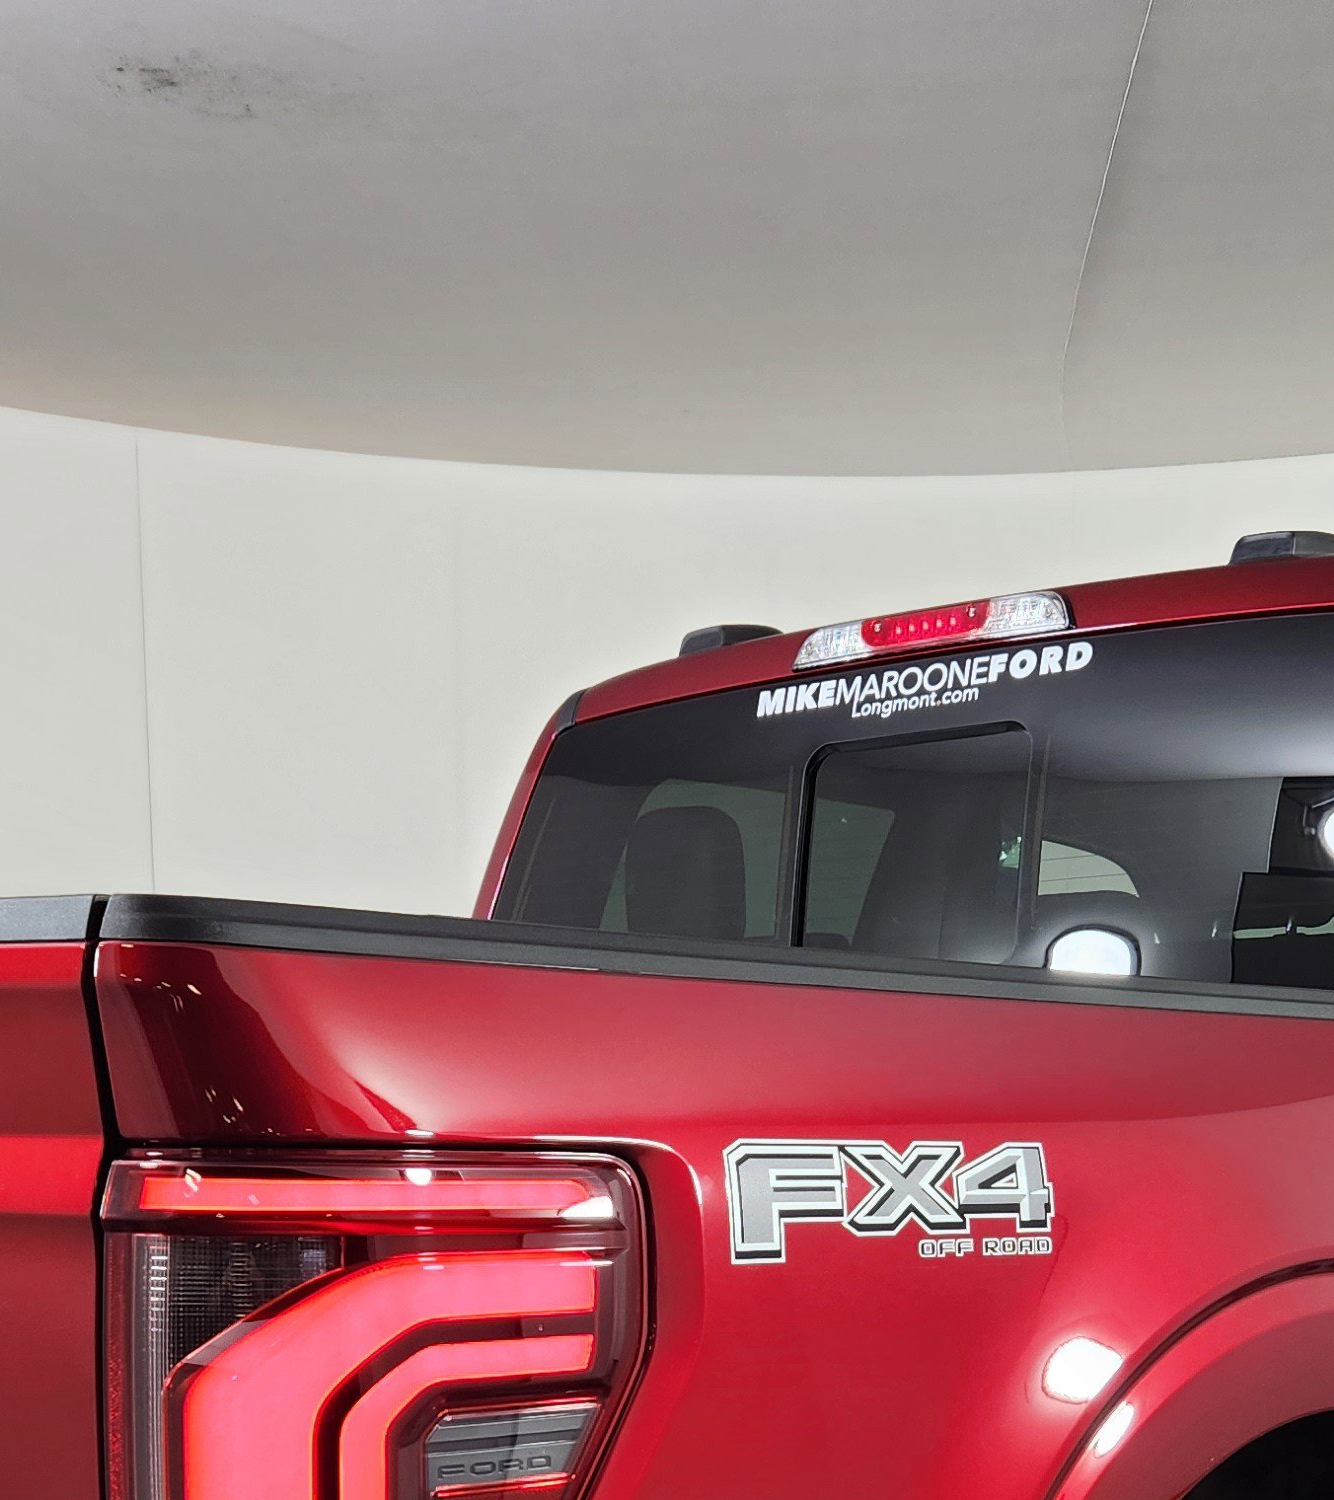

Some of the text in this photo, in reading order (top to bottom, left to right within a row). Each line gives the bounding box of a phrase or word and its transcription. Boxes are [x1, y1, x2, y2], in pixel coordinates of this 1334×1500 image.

[850, 686, 979, 719] Longmont.com
[723, 1138, 1055, 1265] FX4
[919, 1236, 1053, 1258] OFF ROAD
[437, 1455, 552, 1479] FORD
